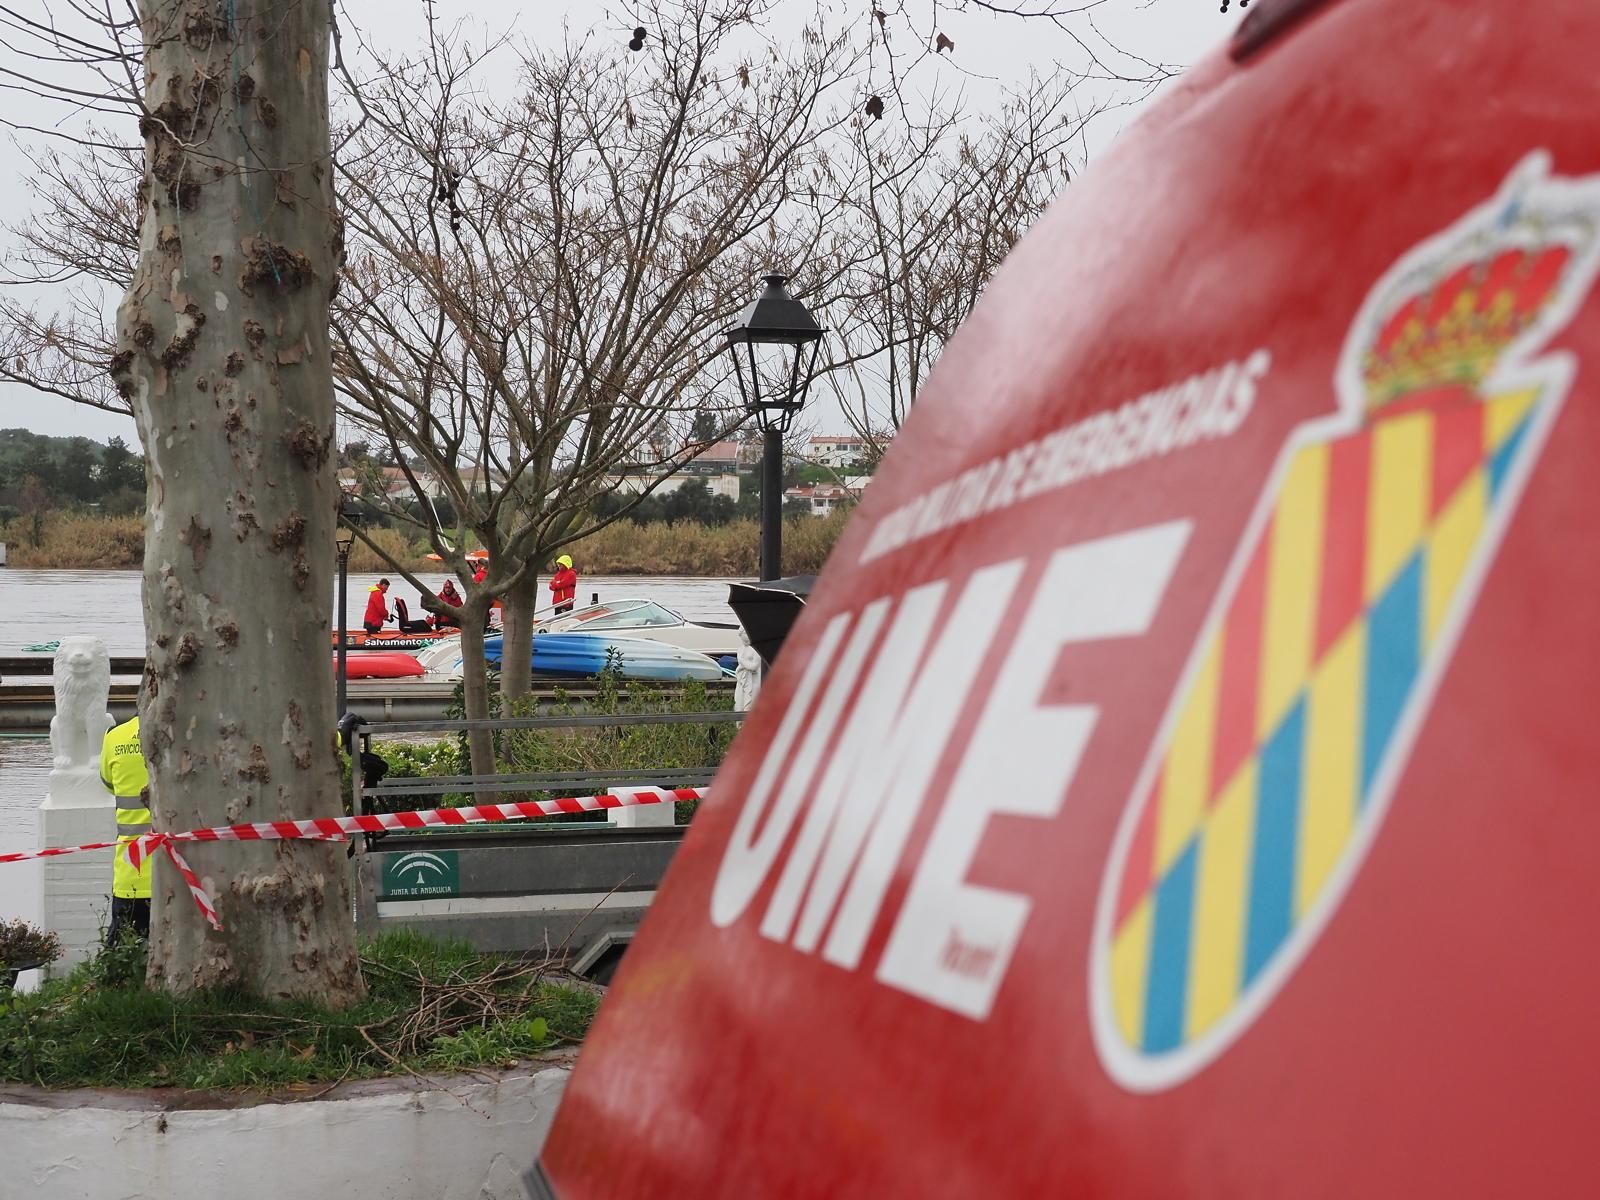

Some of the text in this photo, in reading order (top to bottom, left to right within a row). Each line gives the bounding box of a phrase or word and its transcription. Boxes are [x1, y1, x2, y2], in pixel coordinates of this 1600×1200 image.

[364, 638, 446, 646] Salvamento Mar
[710, 518, 1194, 1021] UME
[410, 887, 418, 895] DE
